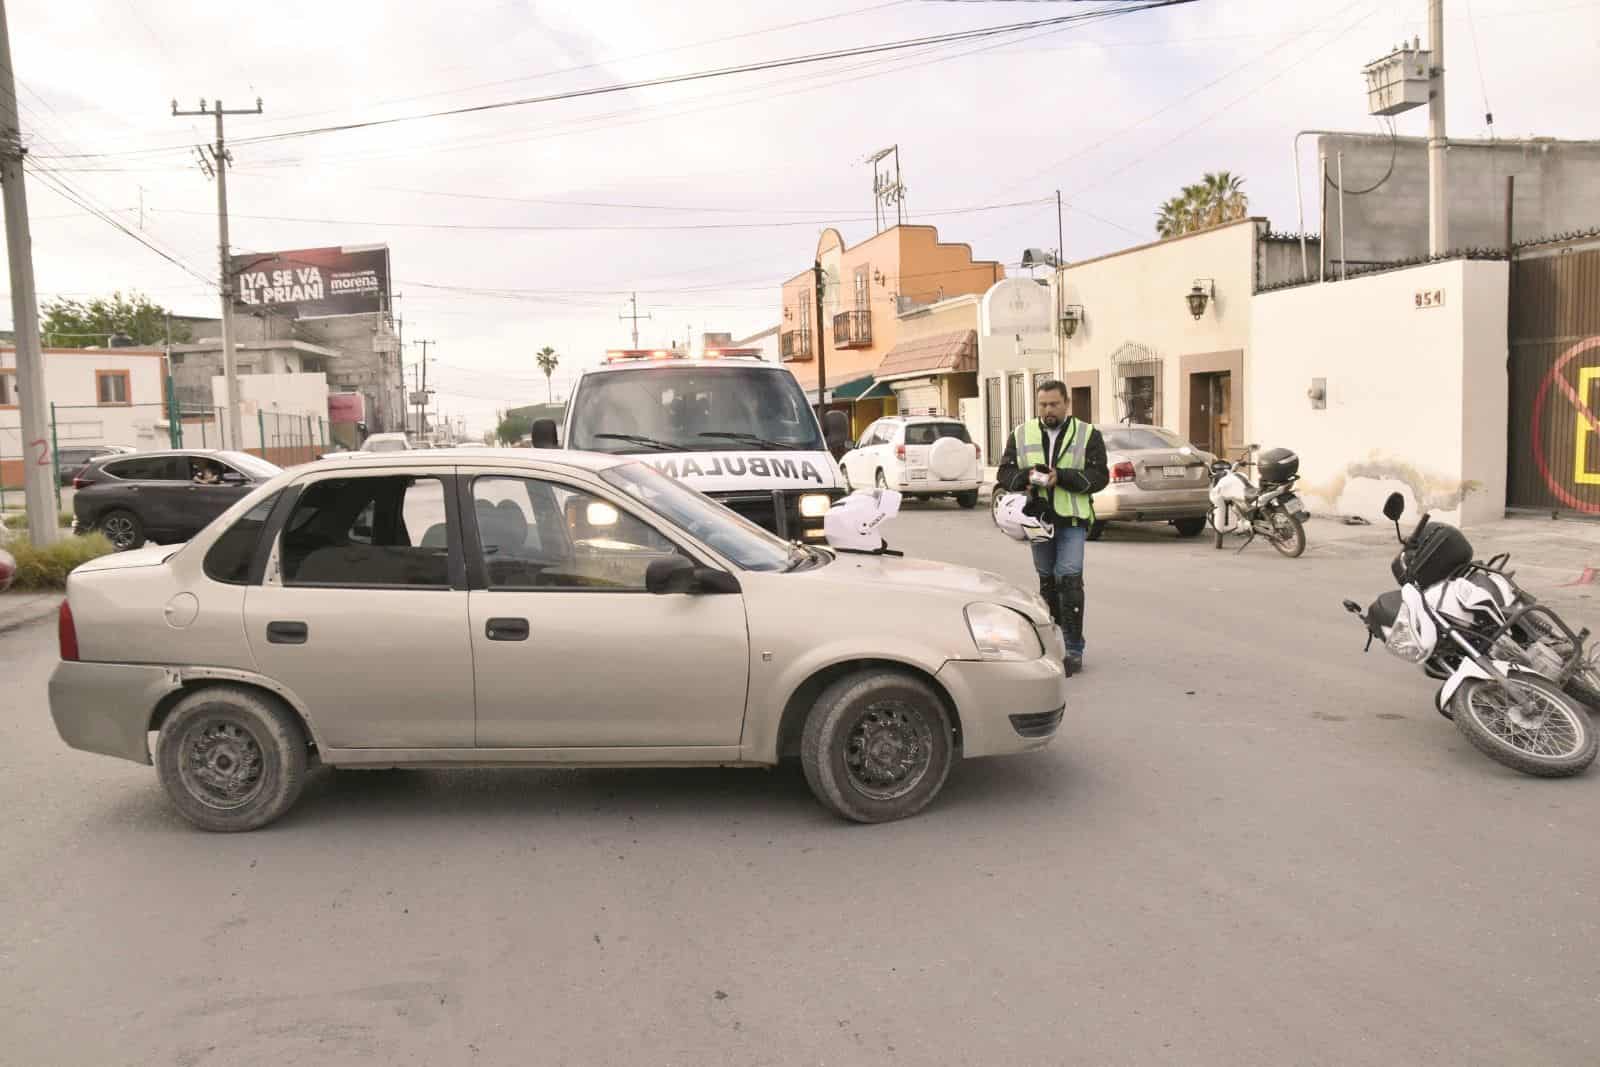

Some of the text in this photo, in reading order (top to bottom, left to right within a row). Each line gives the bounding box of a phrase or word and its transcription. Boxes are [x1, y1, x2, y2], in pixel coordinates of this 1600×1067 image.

[272, 270, 293, 286] SE
[295, 267, 321, 284] VA
[331, 276, 378, 289] morena
[240, 288, 260, 304] EL
[30, 437, 49, 465] 2
